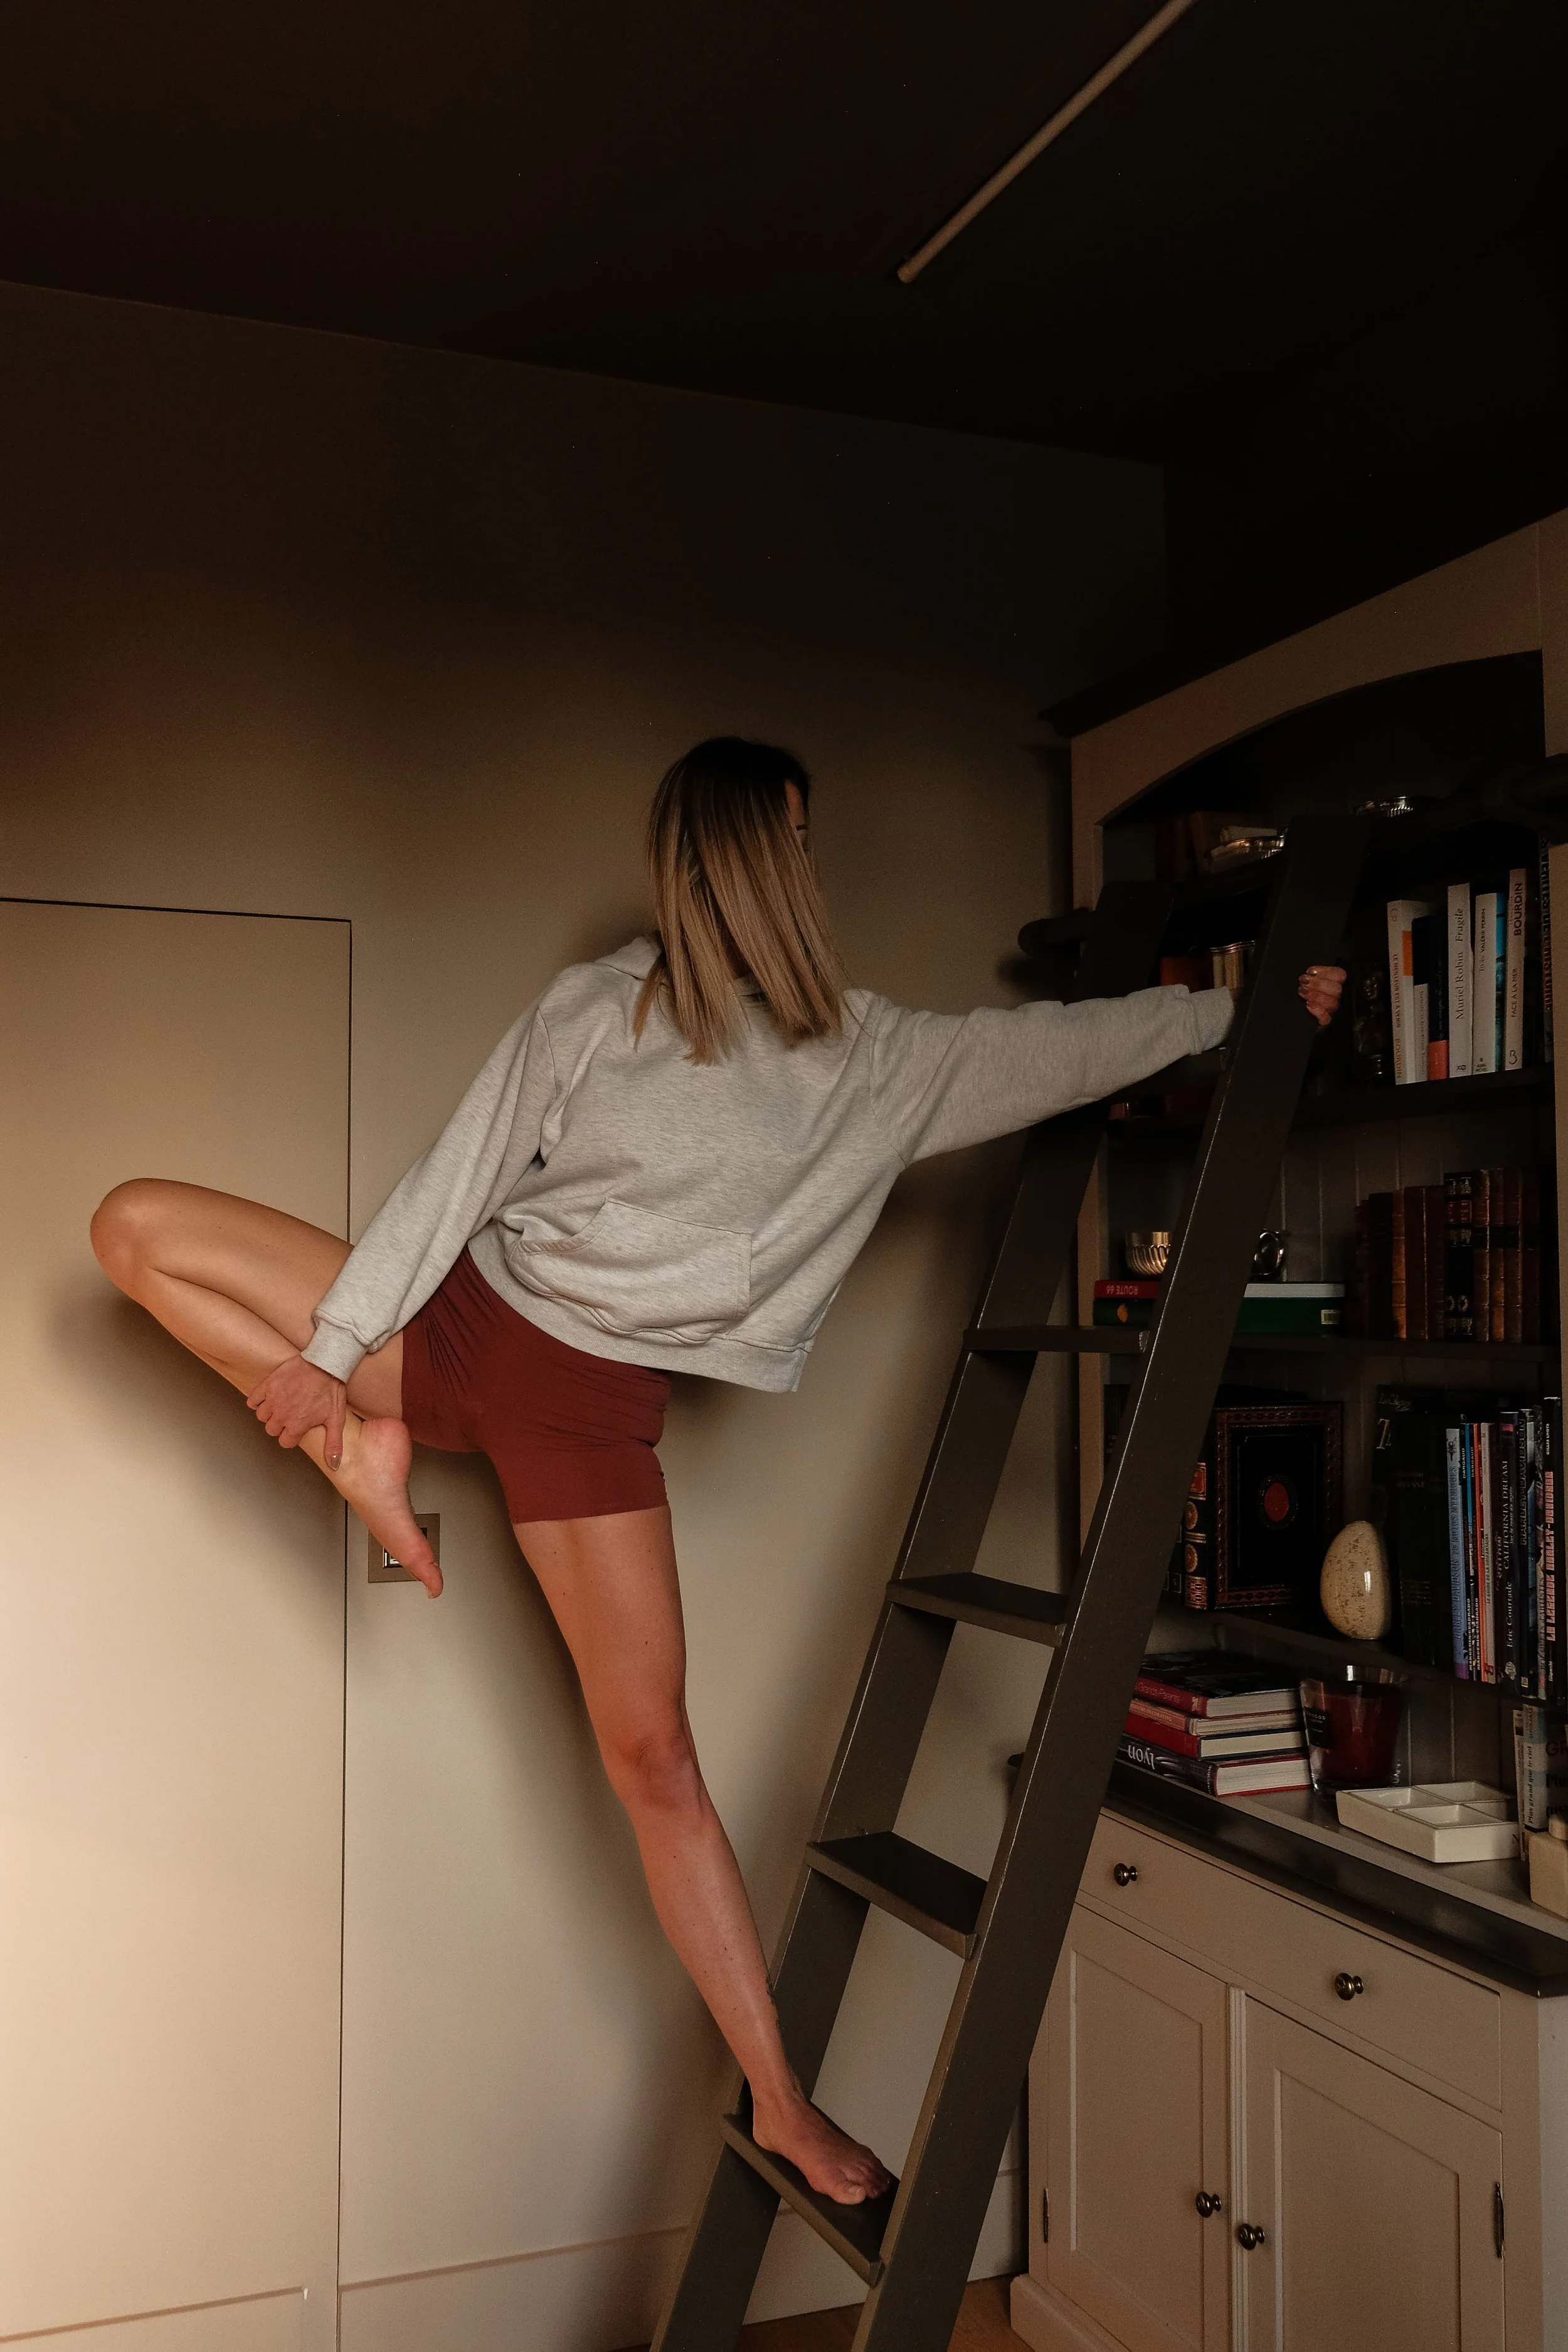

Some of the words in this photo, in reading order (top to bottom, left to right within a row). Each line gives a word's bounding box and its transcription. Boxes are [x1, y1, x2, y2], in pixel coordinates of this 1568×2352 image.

[1456, 908, 1465, 942] Fragile
[1513, 882, 1523, 936] BOURDIN
[1455, 951, 1465, 982] Robin
[1455, 983, 1465, 1020] Muriel
[1512, 983, 1517, 992] LA
[1394, 1038, 1402, 1079] BOURDIN
[1106, 1285, 1115, 1295] 66
[1116, 1285, 1139, 1295] ROUTE
[1448, 1467, 1458, 1513] MYTHIQUES
[1518, 1419, 1527, 1545] HARLEY-DAVIDSON
[1449, 1517, 1459, 1543] MOTOS
[1544, 1471, 1555, 1571] HARLEY-DAVIDSON
[1451, 1559, 1460, 1602] DAVIDSON
[1505, 1581, 1513, 1626] Courtade
[1452, 1605, 1461, 1640] HARLEY
[1545, 1626, 1555, 1641] LA
